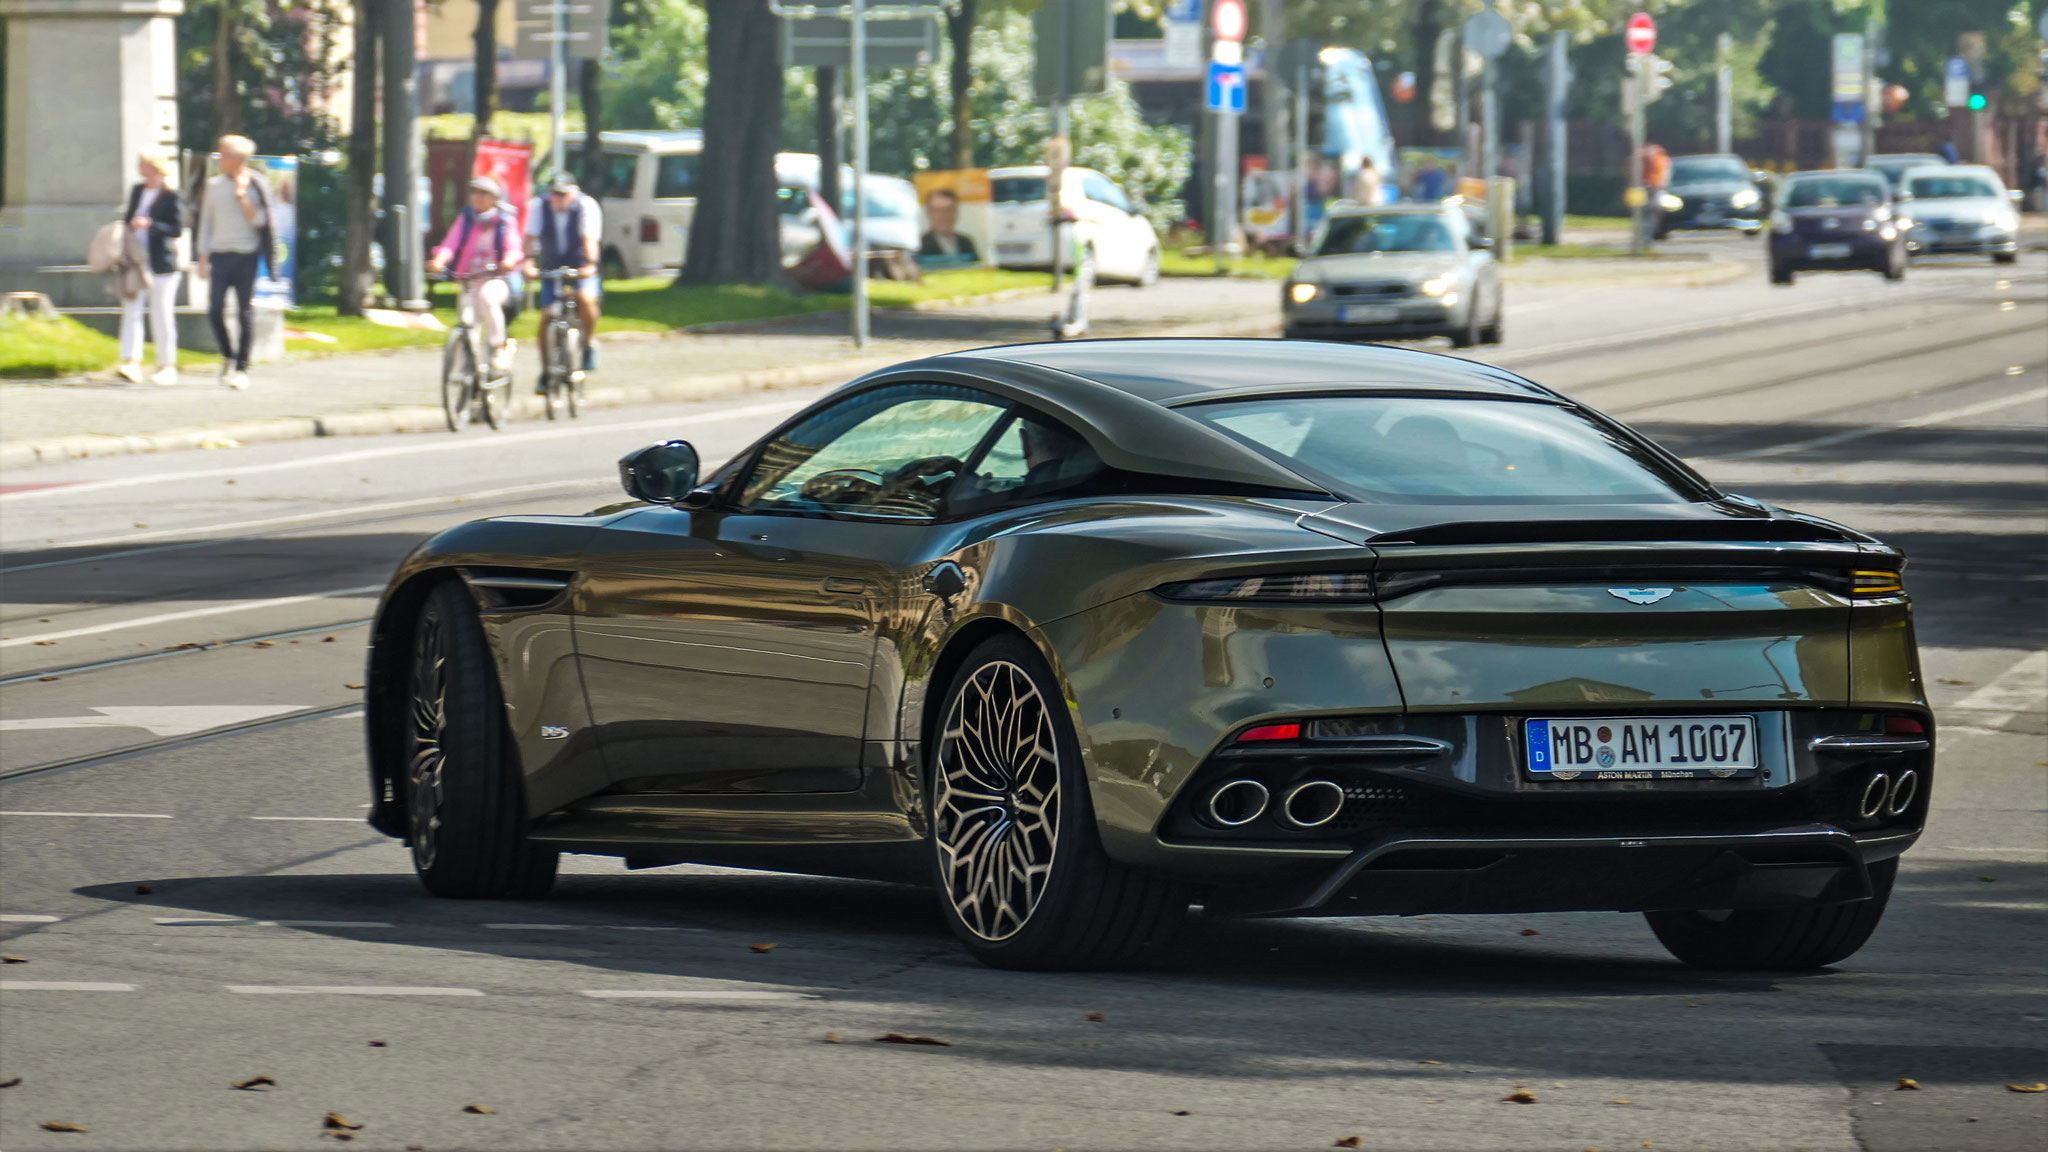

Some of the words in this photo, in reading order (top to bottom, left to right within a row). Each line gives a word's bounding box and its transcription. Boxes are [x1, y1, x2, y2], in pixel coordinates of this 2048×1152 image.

[1552, 726, 1593, 765] MB
[1621, 724, 1661, 764] AM
[1669, 724, 1746, 763] 1007
[1536, 751, 1545, 762] D
[1597, 771, 1622, 780] ASTON
[1624, 771, 1652, 780] MARTIN
